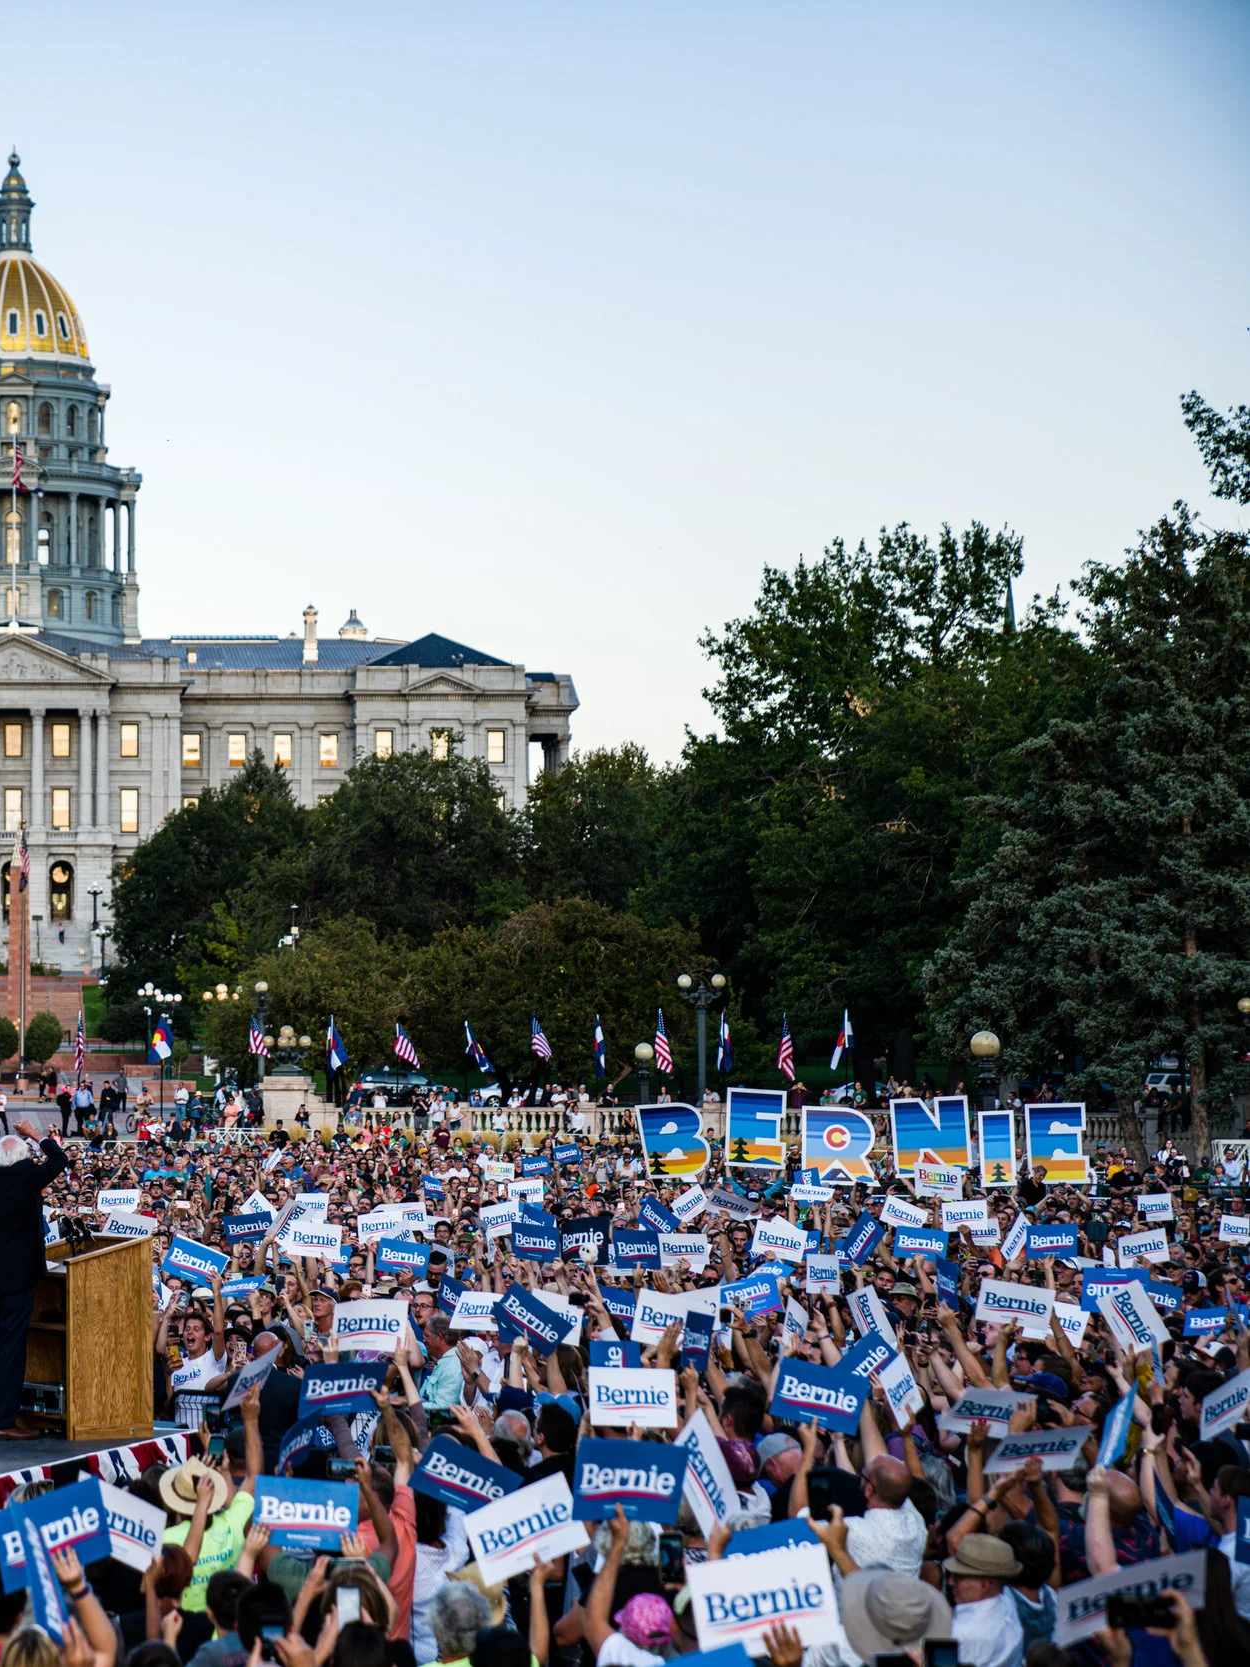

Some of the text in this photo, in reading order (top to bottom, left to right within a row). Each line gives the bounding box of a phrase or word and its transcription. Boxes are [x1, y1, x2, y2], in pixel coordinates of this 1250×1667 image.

[635, 1087, 1090, 1188] BERNIE
[556, 1148, 578, 1159] Bernie
[486, 1164, 512, 1173] Bernie
[524, 1160, 548, 1170] Bernie
[918, 1168, 958, 1184] Bernie
[101, 1196, 134, 1204] Bernie
[511, 1186, 541, 1198] Bernie
[794, 1187, 830, 1196] Bernie
[305, 1201, 325, 1210] rnie
[676, 1193, 703, 1216] Bernie
[712, 1195, 748, 1213] Bernie
[1139, 1202, 1169, 1213] Bernie
[277, 1205, 306, 1240] Benie
[403, 1213, 424, 1222] Ber
[483, 1211, 516, 1224] Bernie
[643, 1206, 671, 1233] Bernie
[886, 1203, 923, 1226] Bernie
[945, 1209, 984, 1221] Bernie
[109, 1220, 148, 1236] Bernie
[228, 1219, 270, 1235] Bernie
[393, 1230, 410, 1242] nie
[1223, 1222, 1248, 1234] Bern
[293, 1231, 337, 1246] Bernie
[515, 1232, 556, 1250] Bernie
[562, 1228, 604, 1250] Bernie
[663, 1242, 705, 1253] Bernie
[758, 1230, 801, 1250] Bernie
[848, 1221, 876, 1257] Bernie
[898, 1234, 944, 1251] Bernie
[1005, 1222, 1027, 1257] Bernie
[1030, 1234, 1074, 1246] Bernie
[1122, 1239, 1164, 1256] Bernie
[381, 1248, 426, 1266] Bernie
[617, 1241, 658, 1255] Bernie
[170, 1247, 218, 1272] Bernie
[753, 1266, 782, 1275] ernie
[809, 1265, 838, 1280] Bernie
[442, 1284, 459, 1303] Ber
[724, 1282, 771, 1302] Bernie
[1148, 1291, 1177, 1308] nie
[459, 1302, 493, 1315] Bern
[605, 1298, 636, 1315] Berni
[984, 1291, 1047, 1315] Bernie
[337, 1314, 400, 1332] Bernie
[503, 1294, 559, 1342] Bernie
[641, 1306, 683, 1322] Bern
[857, 1293, 882, 1335] Bern
[1058, 1314, 1082, 1331] nie
[1115, 1290, 1152, 1344] Bernie
[1189, 1313, 1245, 1328] Bere
[852, 1345, 890, 1378] rnie
[305, 1374, 377, 1397] Bernie
[780, 1375, 858, 1413] Bernie
[596, 1385, 669, 1405] Bernie
[955, 1399, 1011, 1419] Berni
[1204, 1386, 1249, 1423] Bernie
[1000, 1438, 1077, 1459] Bernie
[424, 1451, 504, 1502] Bernie
[580, 1464, 676, 1495] Bernie
[683, 1431, 727, 1519] Bernie
[260, 1495, 351, 1527] Bernie
[478, 1501, 568, 1554] Bernie
[198, 1549, 233, 1565] nough
[705, 1579, 823, 1623] Bernie
